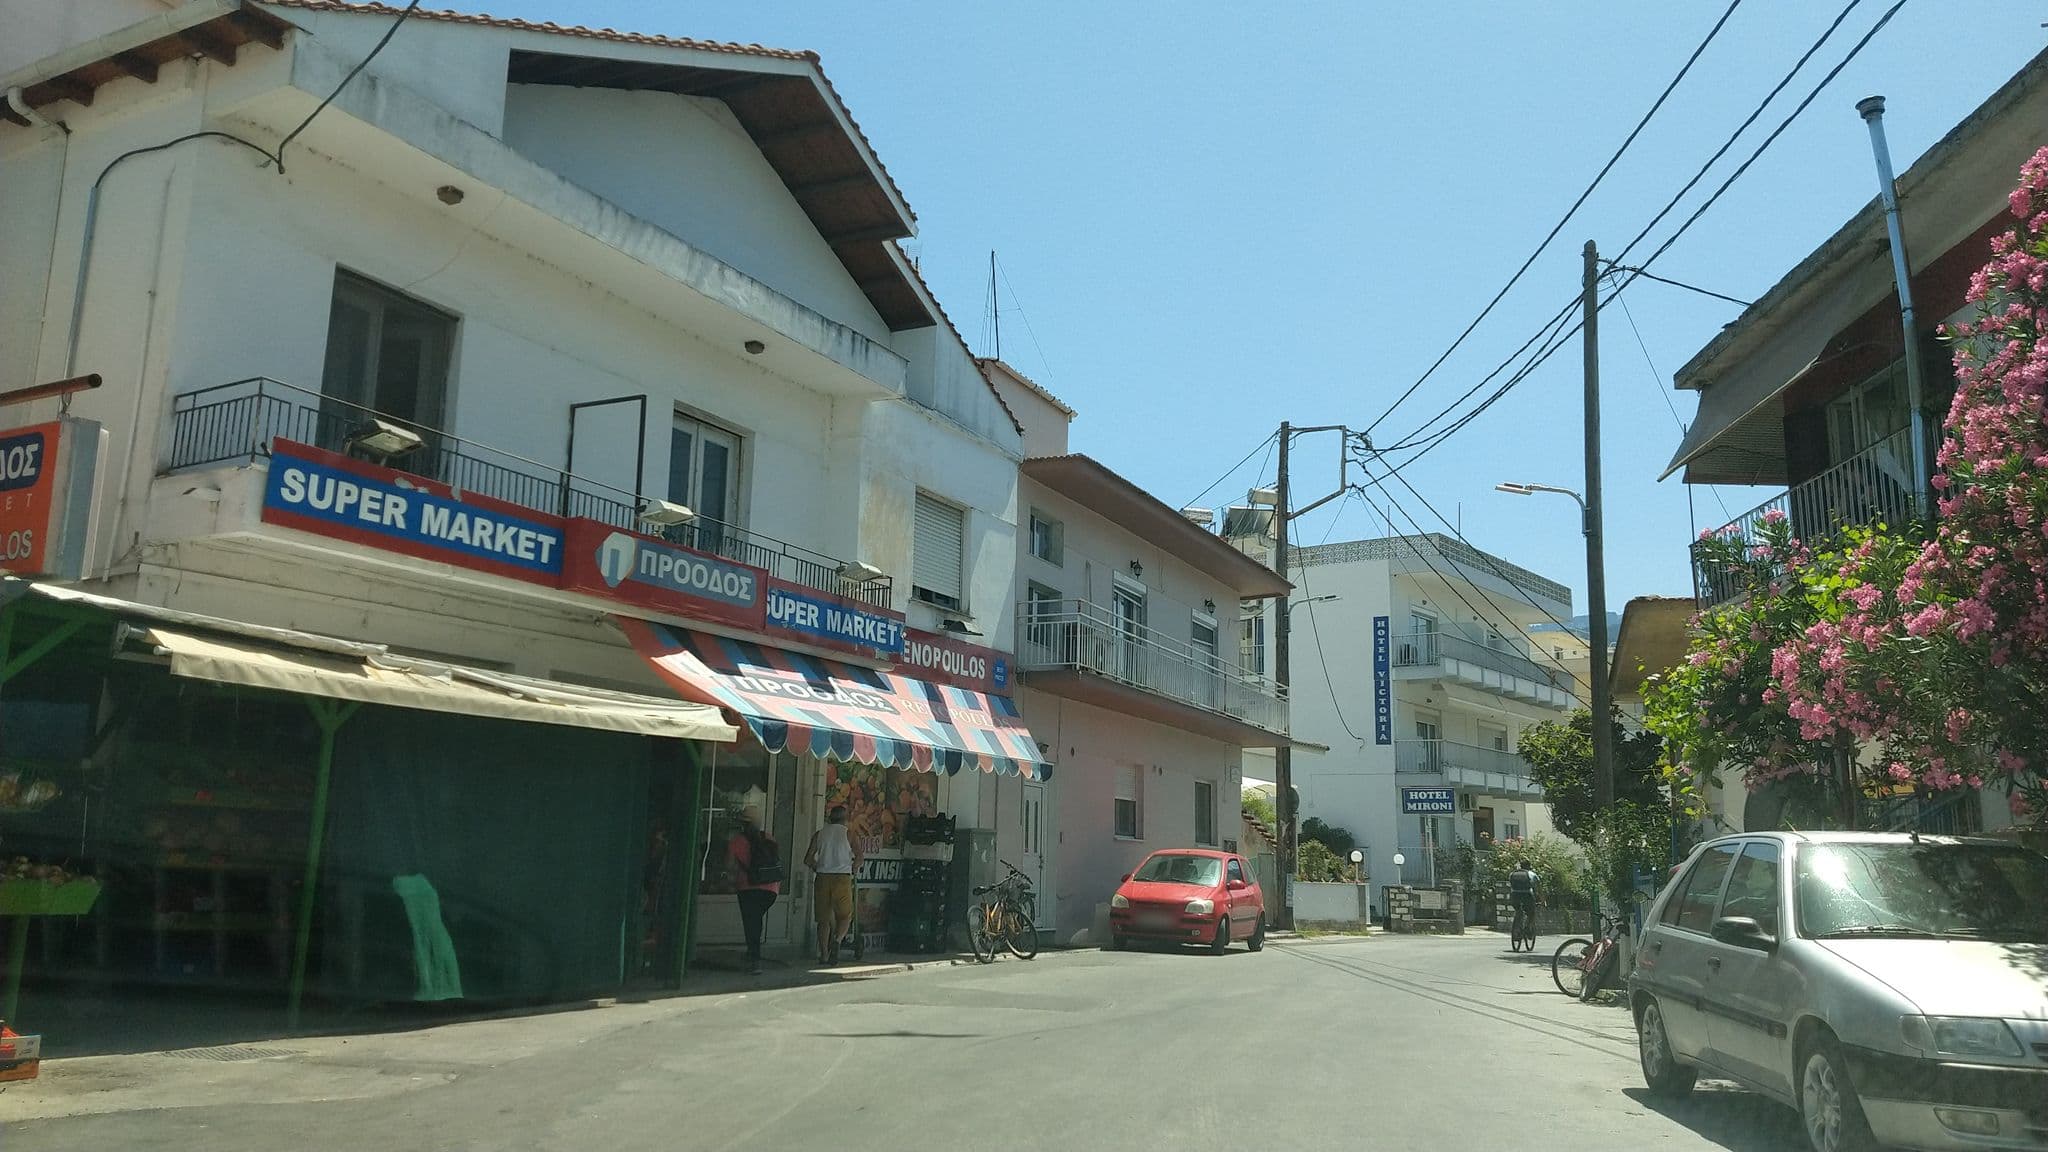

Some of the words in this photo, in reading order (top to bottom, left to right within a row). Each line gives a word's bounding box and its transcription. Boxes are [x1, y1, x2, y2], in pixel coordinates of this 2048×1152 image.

[280, 467, 408, 530] SUPER
[420, 502, 556, 565] MARKET
[640, 549, 752, 601] ΠΡΟΟΔΟΣ
[826, 608, 898, 646] MARKET
[1377, 620, 1386, 662] HOTEL
[1378, 671, 1387, 740] VICTORIA
[1407, 802, 1453, 811] MIRONI
[1409, 791, 1450, 800] HOTEL
